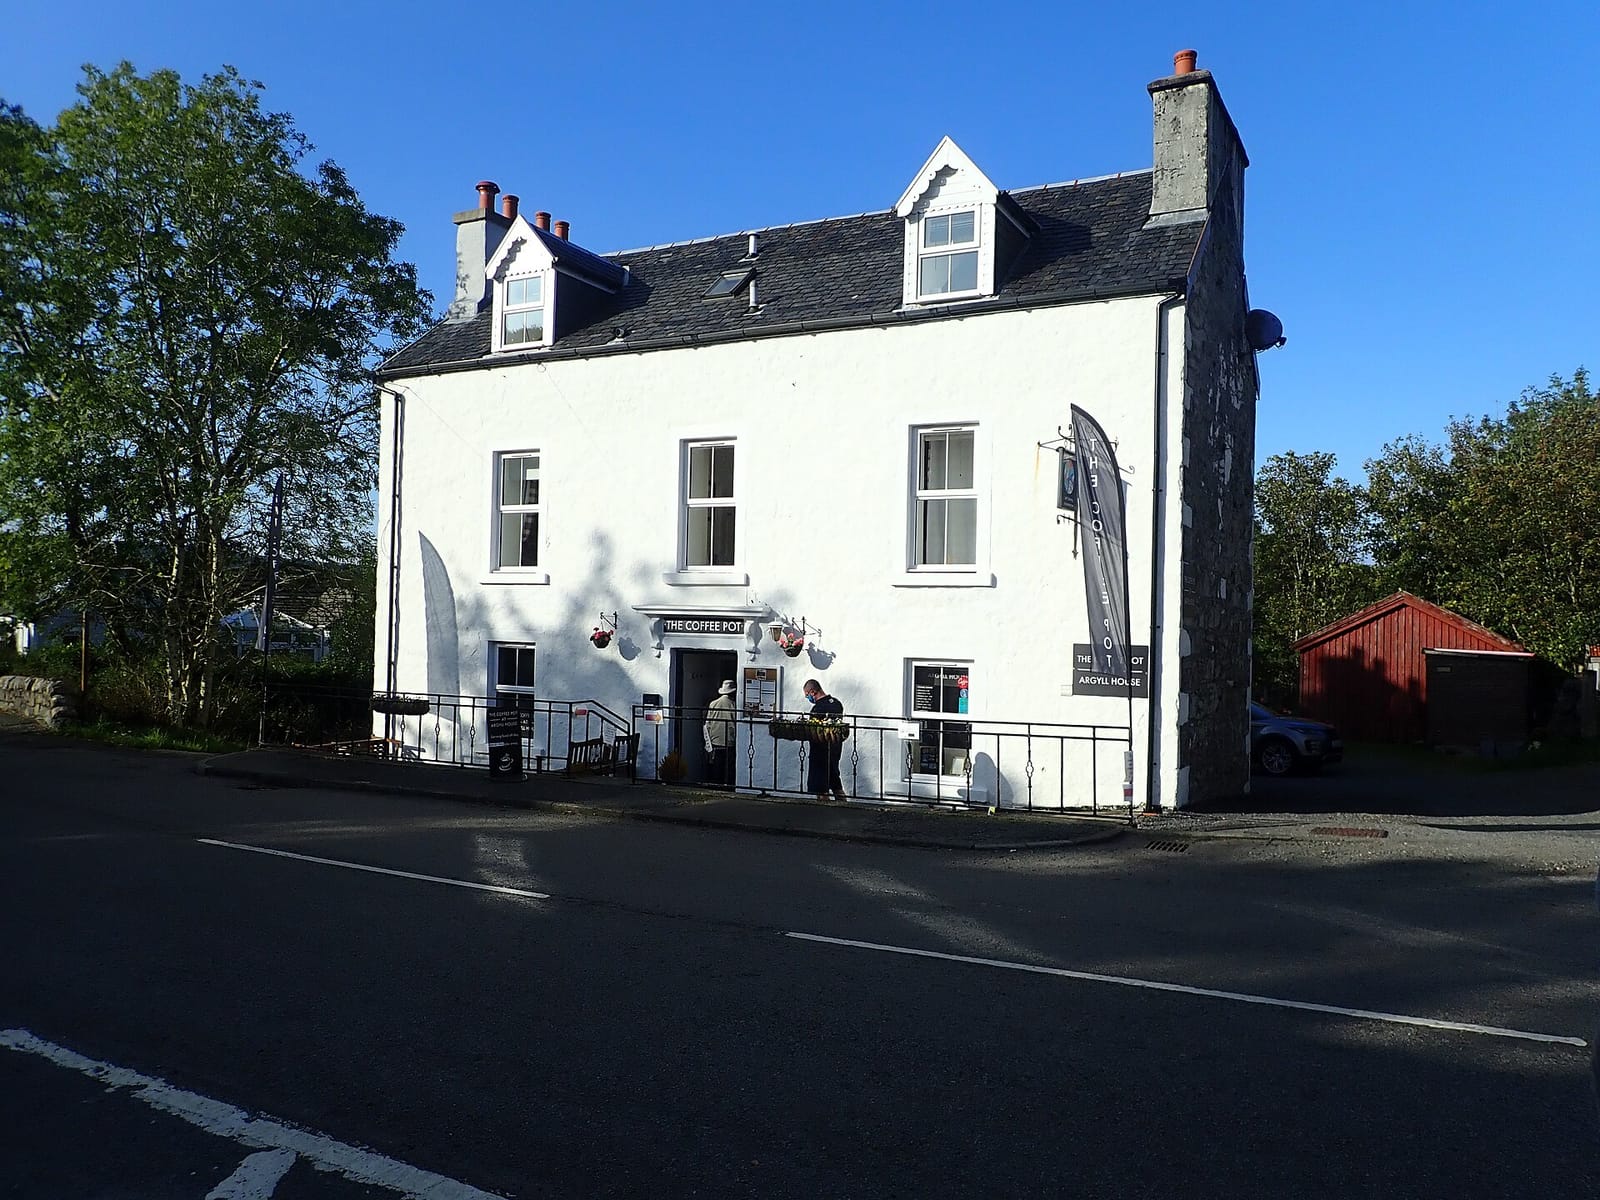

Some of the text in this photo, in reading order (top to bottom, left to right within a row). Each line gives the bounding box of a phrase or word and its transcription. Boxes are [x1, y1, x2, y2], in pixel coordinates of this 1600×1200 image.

[666, 621, 742, 632] THE COFFEE POT
[1077, 655, 1144, 665] THE OT
[1079, 676, 1110, 685] ARGYLL
